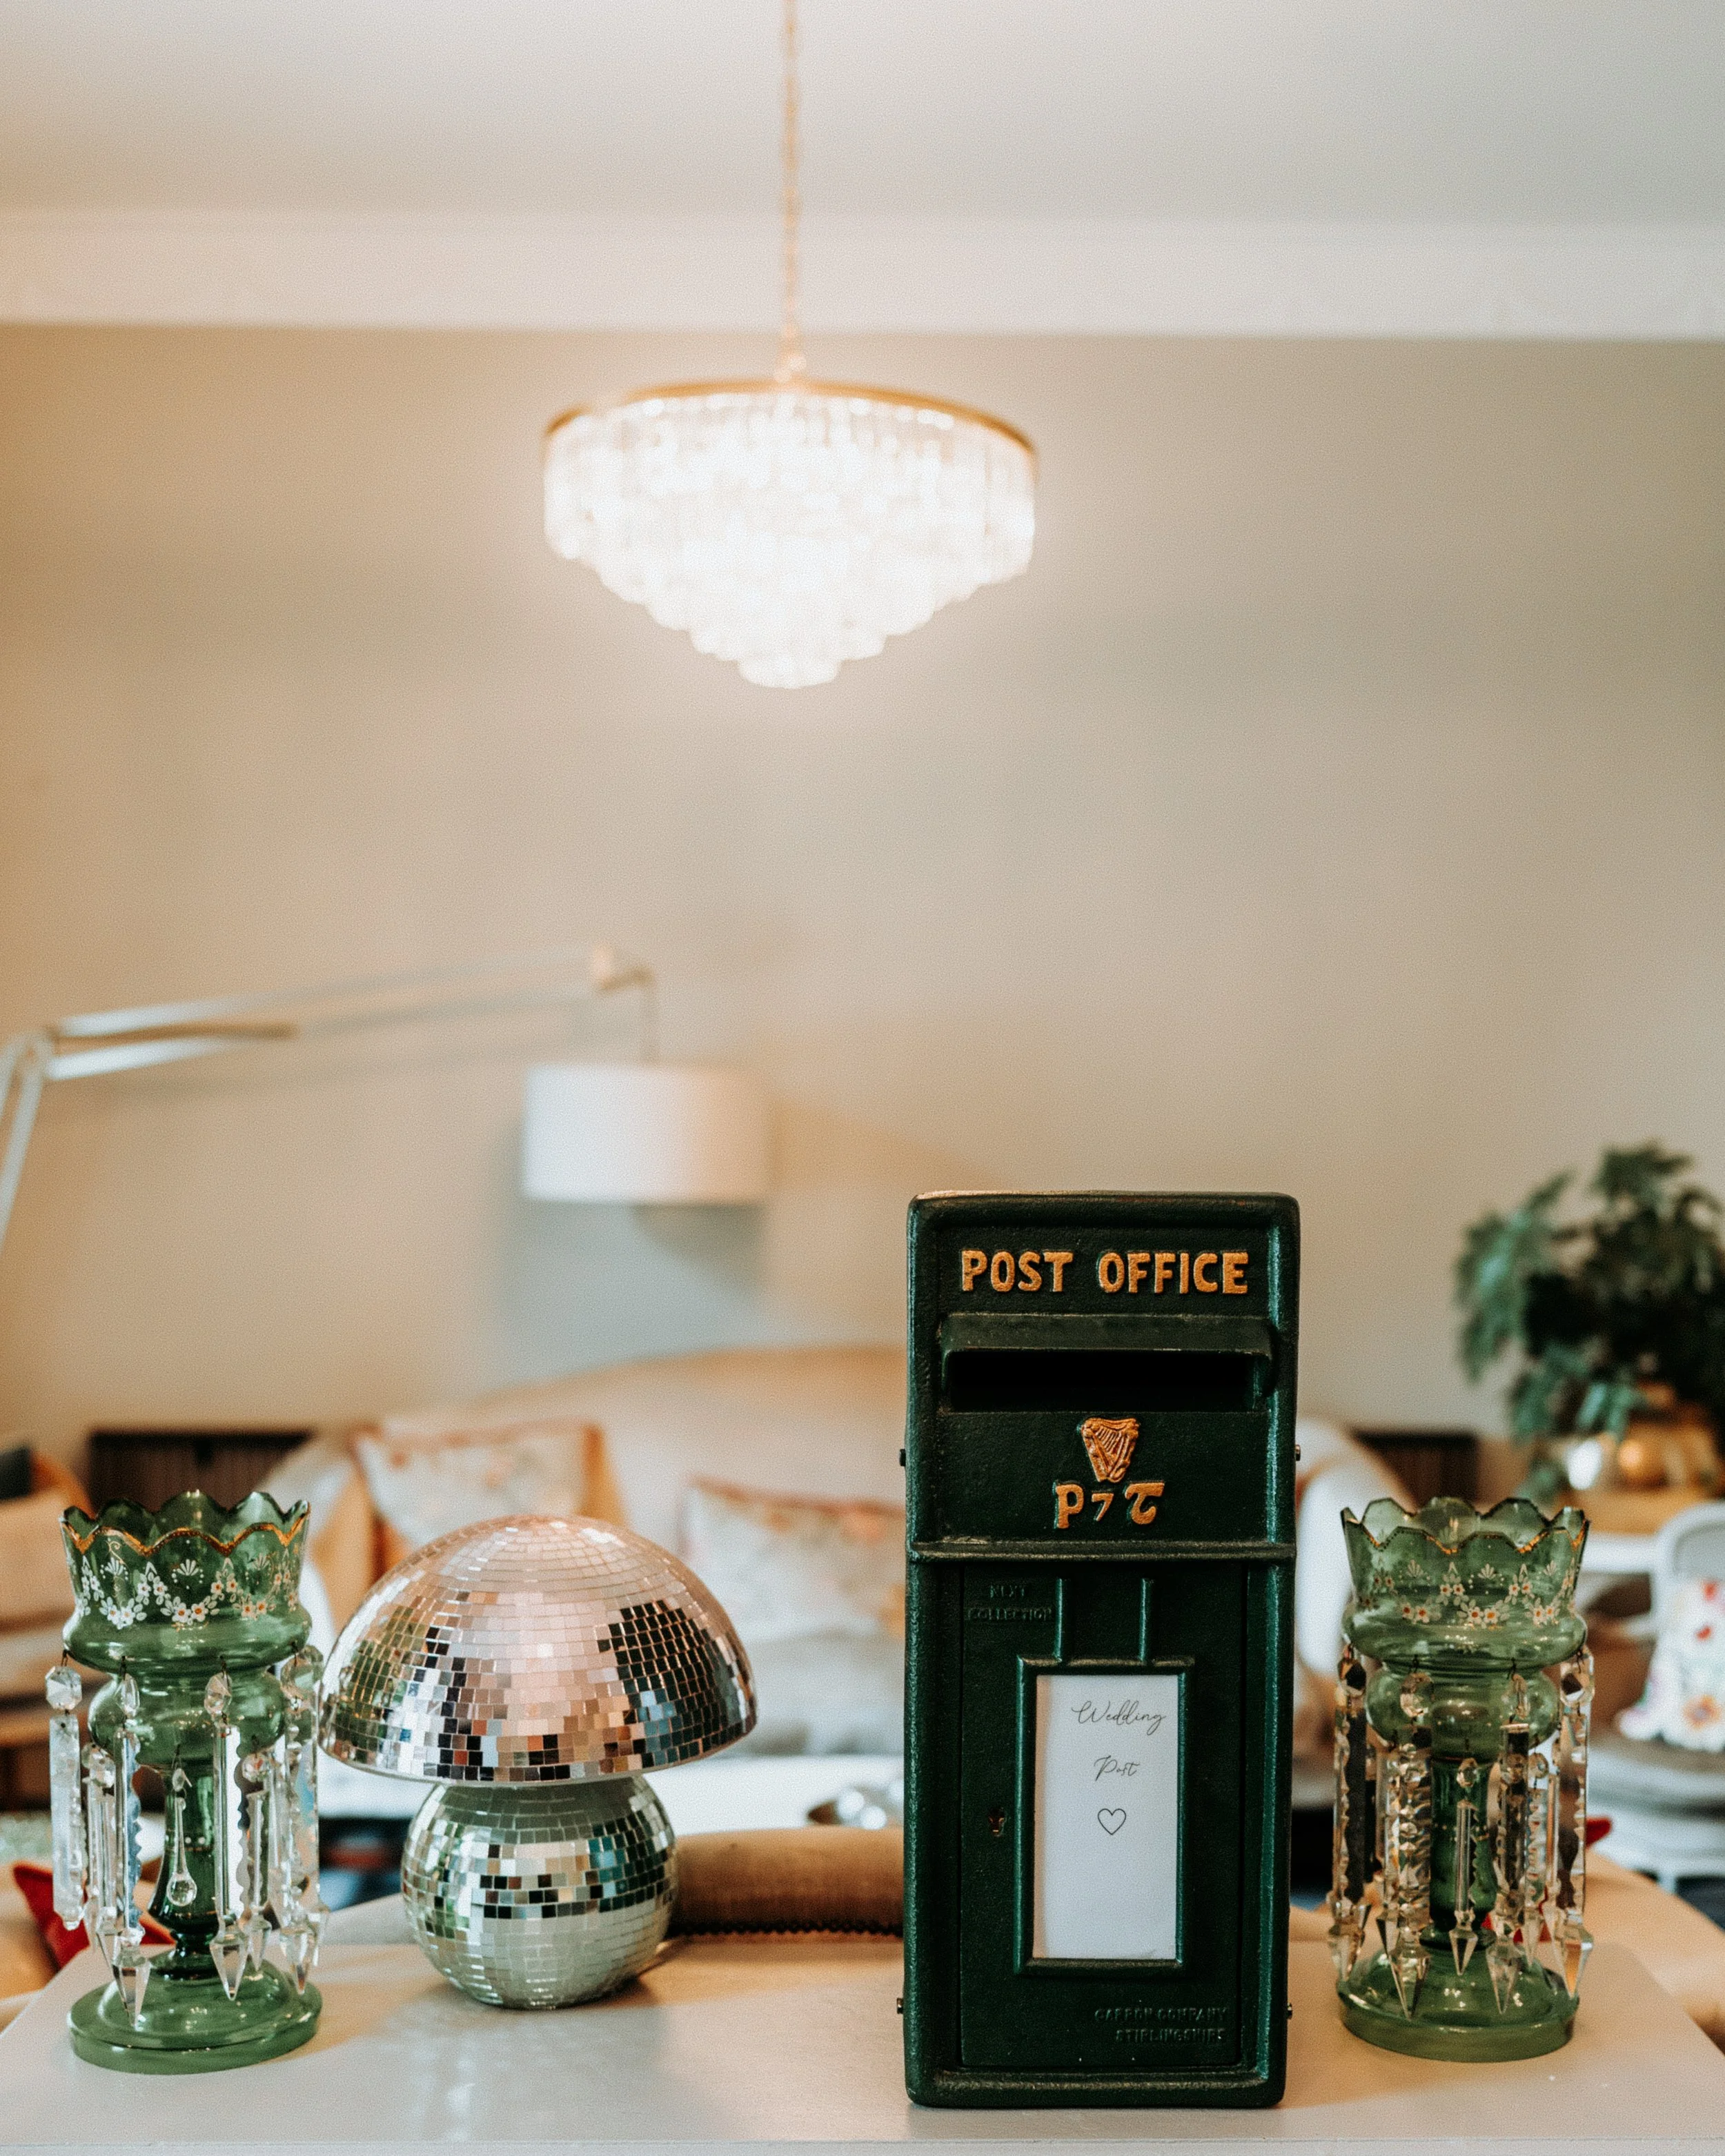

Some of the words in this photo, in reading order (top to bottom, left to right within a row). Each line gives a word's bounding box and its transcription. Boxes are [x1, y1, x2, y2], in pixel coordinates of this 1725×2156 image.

[961, 1249, 1074, 1292] POST
[1097, 1251, 1249, 1294] OFFICE
[967, 1607, 1053, 1621] COLLECTION
[1072, 1700, 1166, 1736] Wedding
[1094, 1754, 1140, 1781] Post
